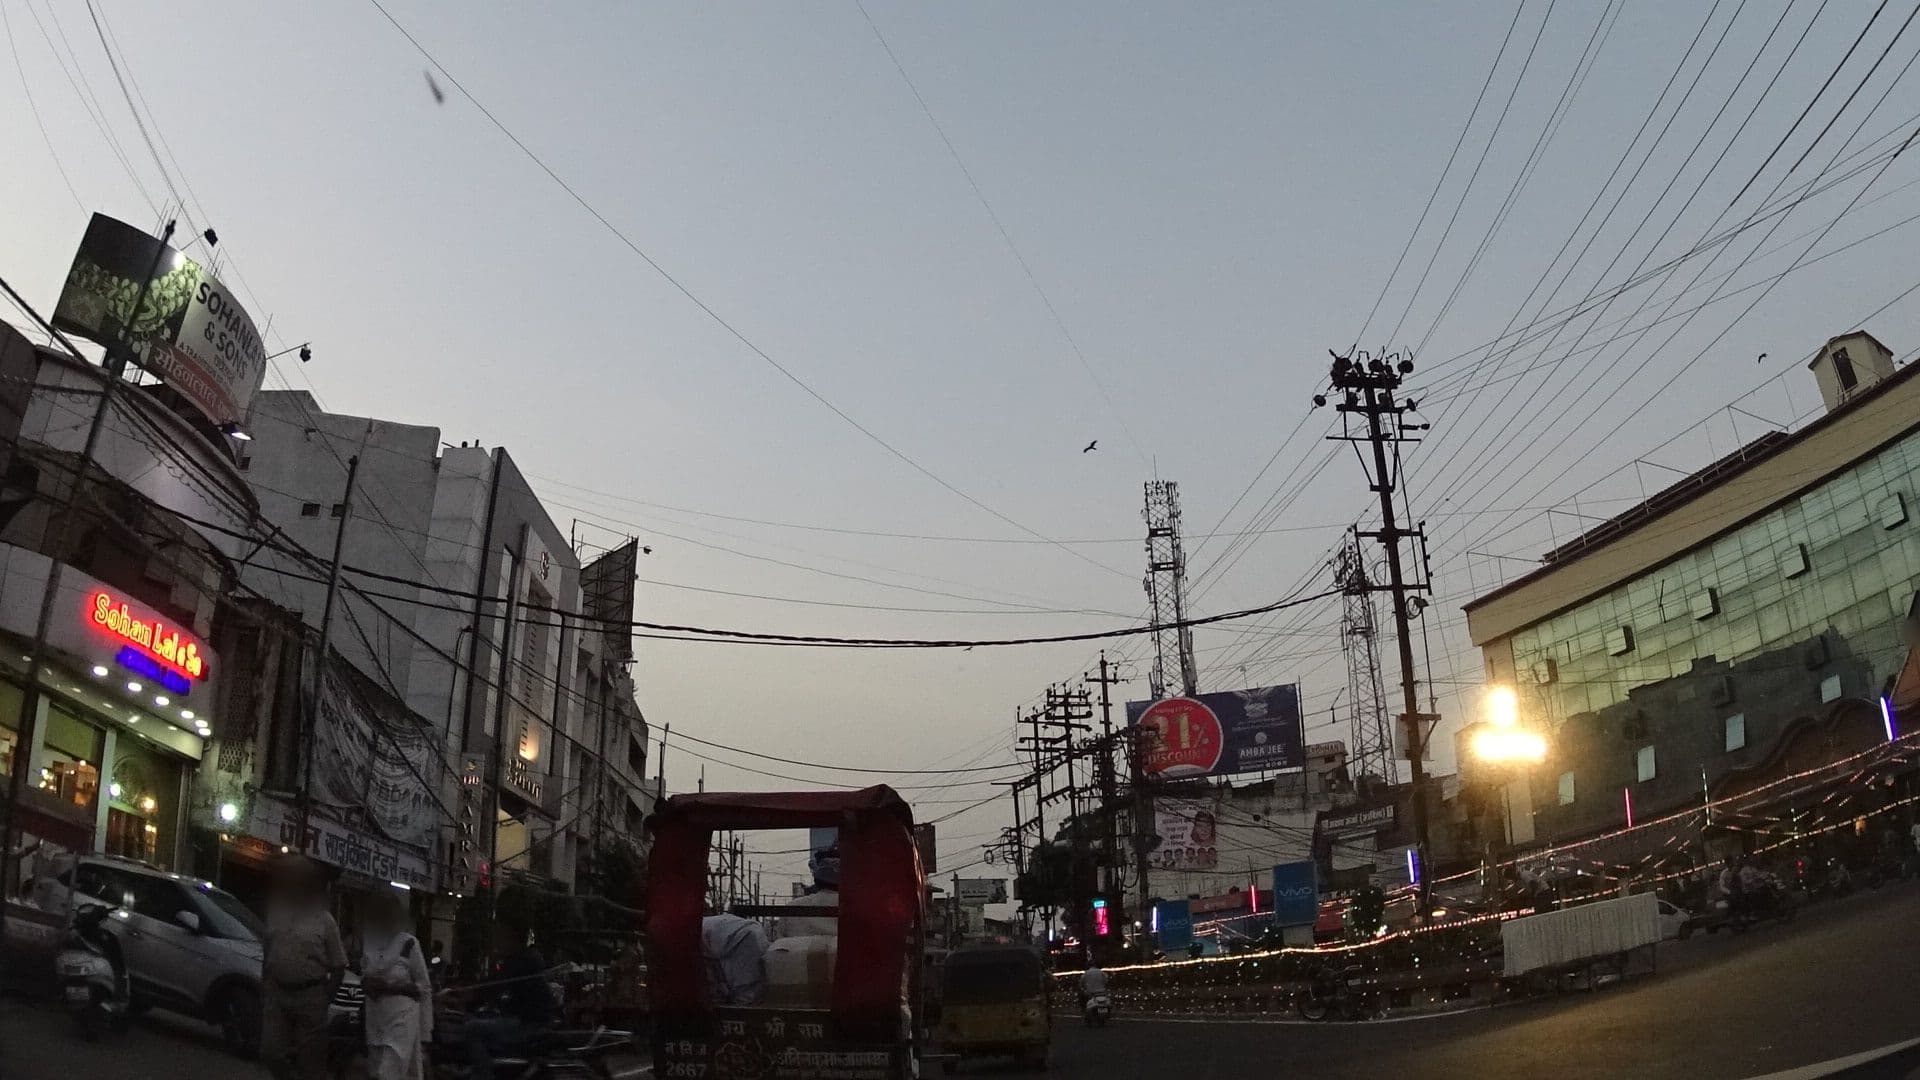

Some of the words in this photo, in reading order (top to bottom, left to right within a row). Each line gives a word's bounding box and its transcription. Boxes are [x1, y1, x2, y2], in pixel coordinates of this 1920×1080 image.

[204, 321, 215, 344] &
[216, 331, 248, 379] SONS
[94, 593, 153, 648] Sohan
[152, 623, 179, 663] Lal
